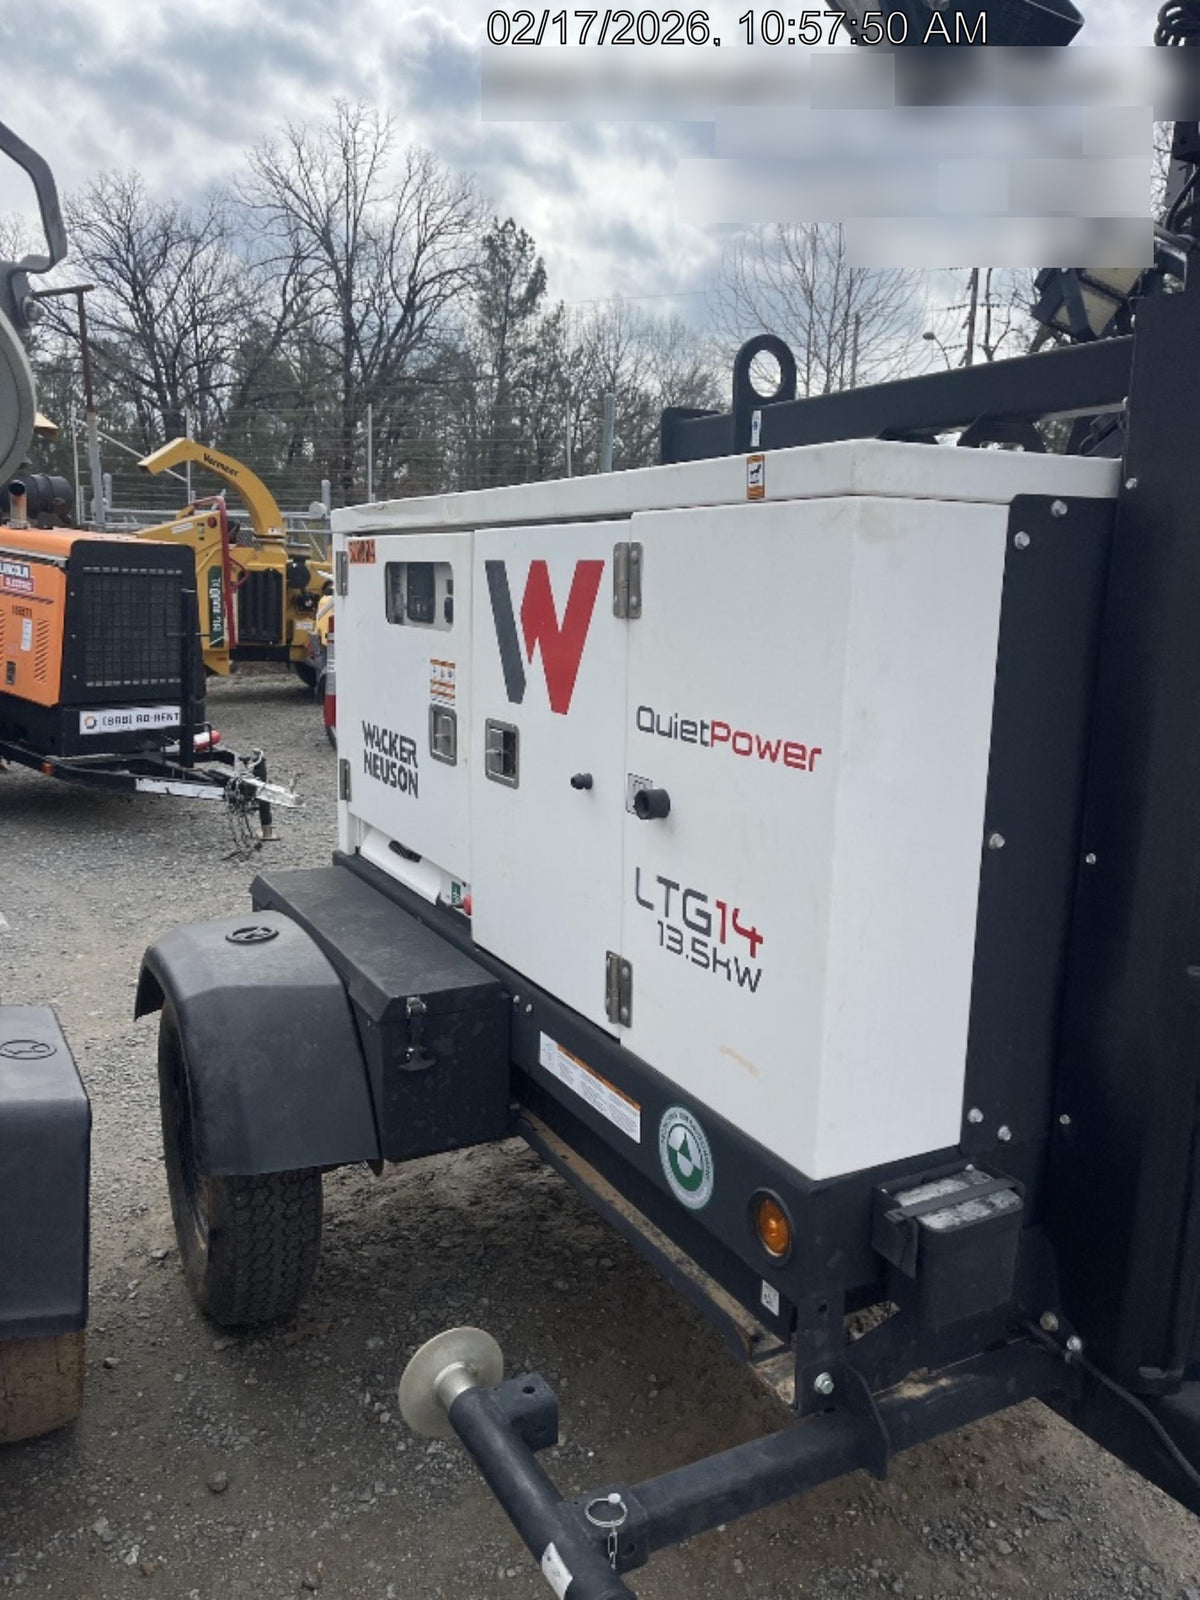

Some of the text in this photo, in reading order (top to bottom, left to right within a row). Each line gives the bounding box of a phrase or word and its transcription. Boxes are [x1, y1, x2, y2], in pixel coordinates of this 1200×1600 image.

[361, 719, 418, 769] WACKER
[636, 705, 822, 772] QuietPower
[363, 749, 419, 799] NEUSON
[635, 867, 764, 959] LTG14
